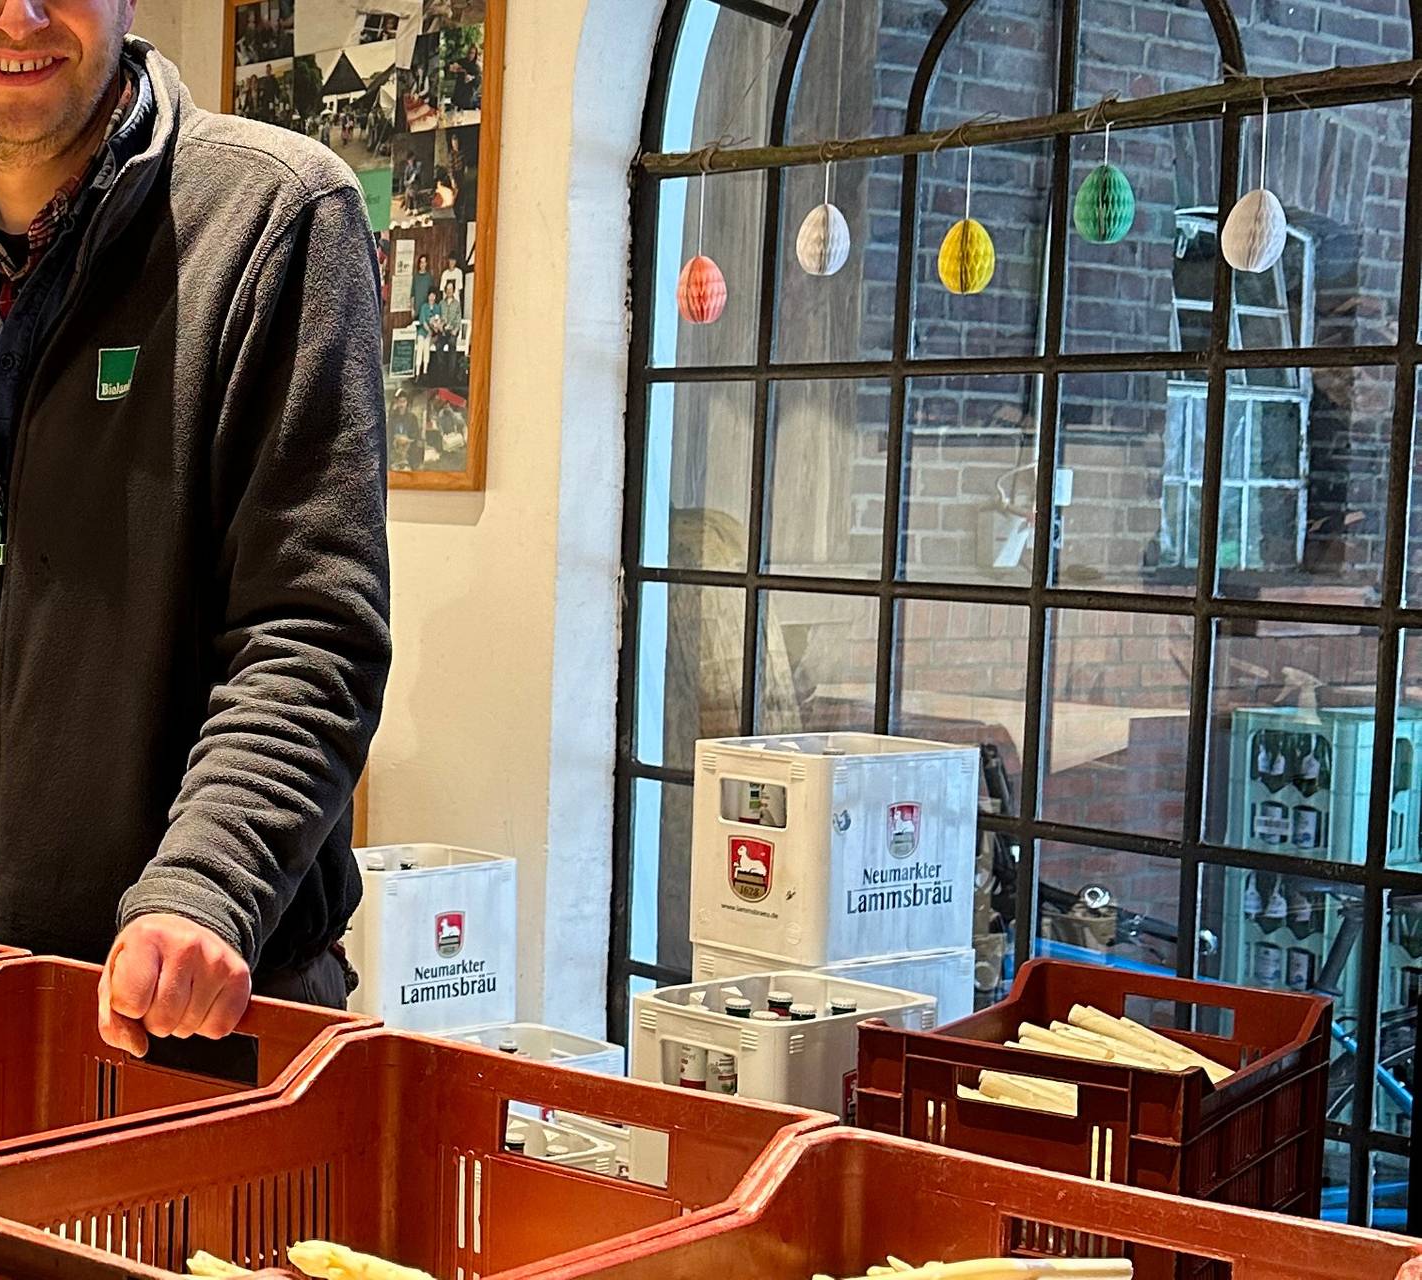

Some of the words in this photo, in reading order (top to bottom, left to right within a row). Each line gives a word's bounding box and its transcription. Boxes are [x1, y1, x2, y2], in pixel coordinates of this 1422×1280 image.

[862, 863, 942, 886] Neumarkter
[846, 880, 953, 915] Lammsbräu
[414, 960, 486, 981] Neumarkter
[401, 973, 497, 1005] Lammsbräu
